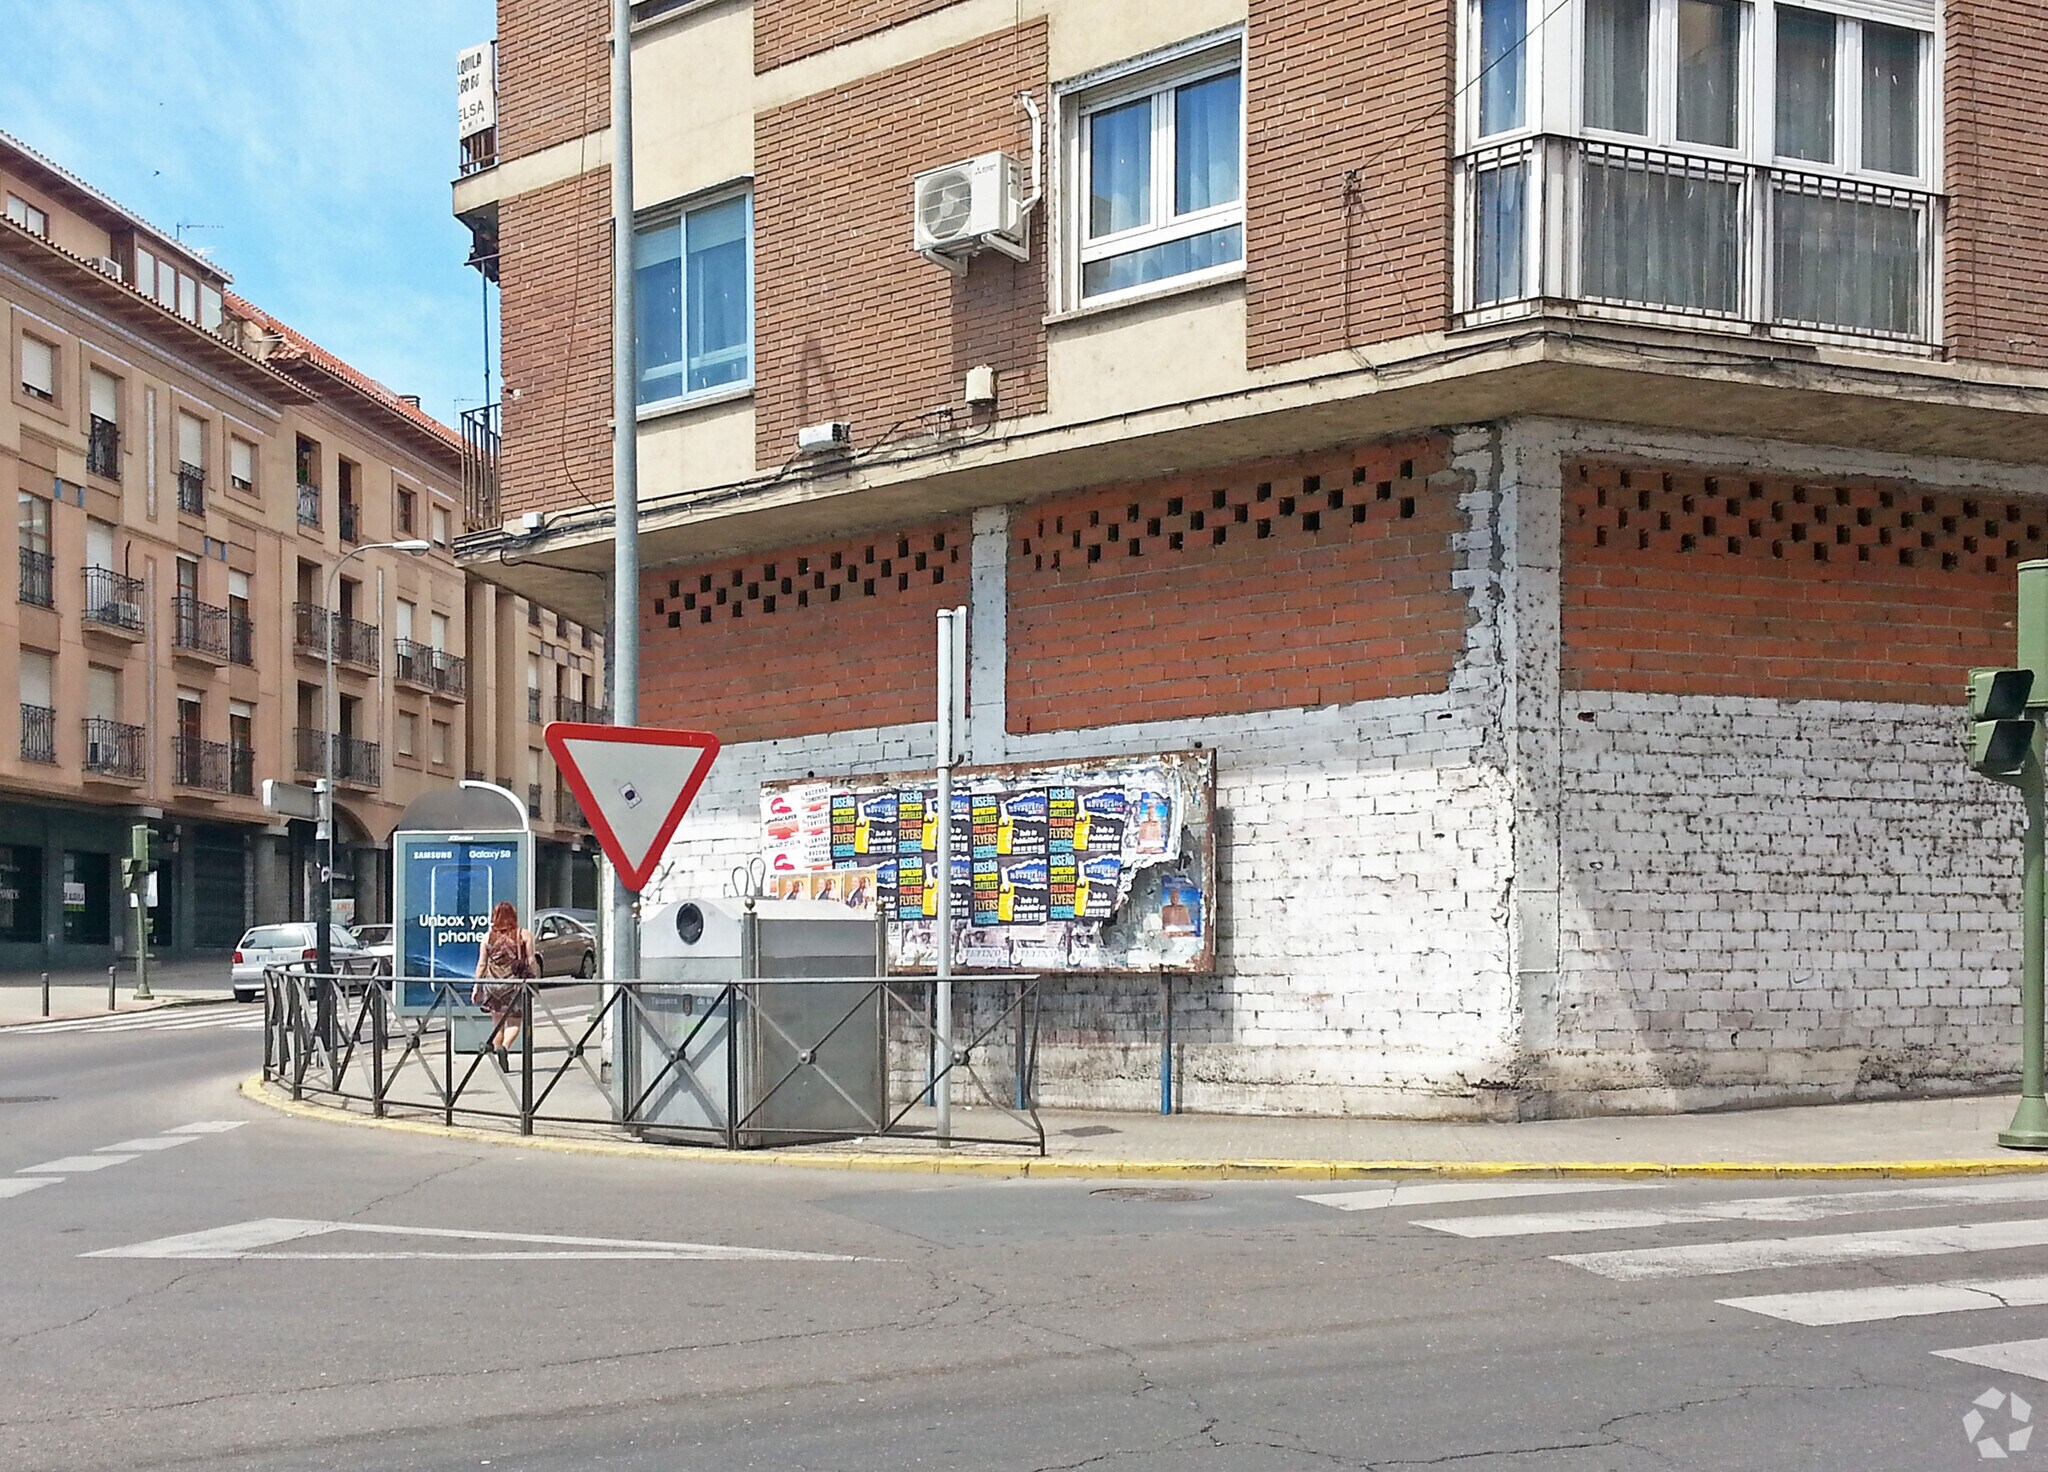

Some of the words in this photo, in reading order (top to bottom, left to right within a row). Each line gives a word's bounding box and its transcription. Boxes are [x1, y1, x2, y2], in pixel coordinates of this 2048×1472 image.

[1049, 787, 1075, 799] DISEÑO
[972, 795, 996, 807] DISEÑO
[899, 830, 922, 840] FLYERS
[1049, 828, 1075, 838] FLYERS
[832, 834, 855, 844] FLYERS
[972, 834, 996, 845] FLYERS
[413, 851, 453, 860] SAMSUNG
[468, 850, 499, 860] Galaxy
[500, 850, 511, 859] S8
[1050, 854, 1075, 866] DISEÑO
[974, 860, 998, 872] DISEÑO
[900, 895, 922, 906] FLYERS
[1050, 894, 1075, 905] FLYERS
[974, 900, 998, 911] FLYERS
[419, 914, 465, 927] Unbox
[467, 914, 494, 930] you
[438, 930, 484, 947] phone
